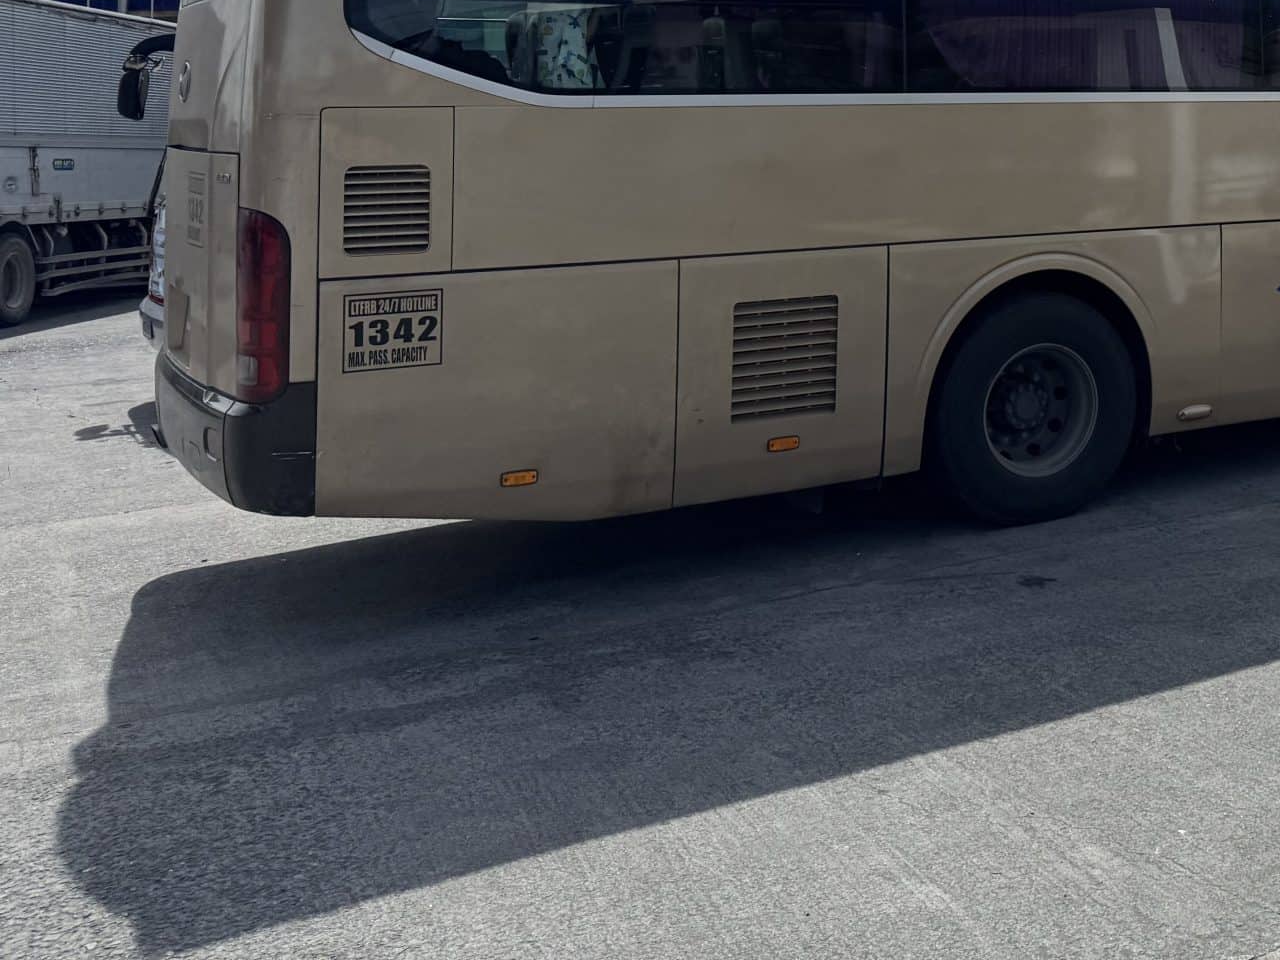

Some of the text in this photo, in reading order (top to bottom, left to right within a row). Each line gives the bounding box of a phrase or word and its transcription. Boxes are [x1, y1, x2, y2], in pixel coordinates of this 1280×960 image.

[351, 296, 436, 316] LTFRB 24/7 HOTLINE
[349, 316, 438, 347] 1342
[348, 347, 427, 368] MAX. PASS. CAPACITY
